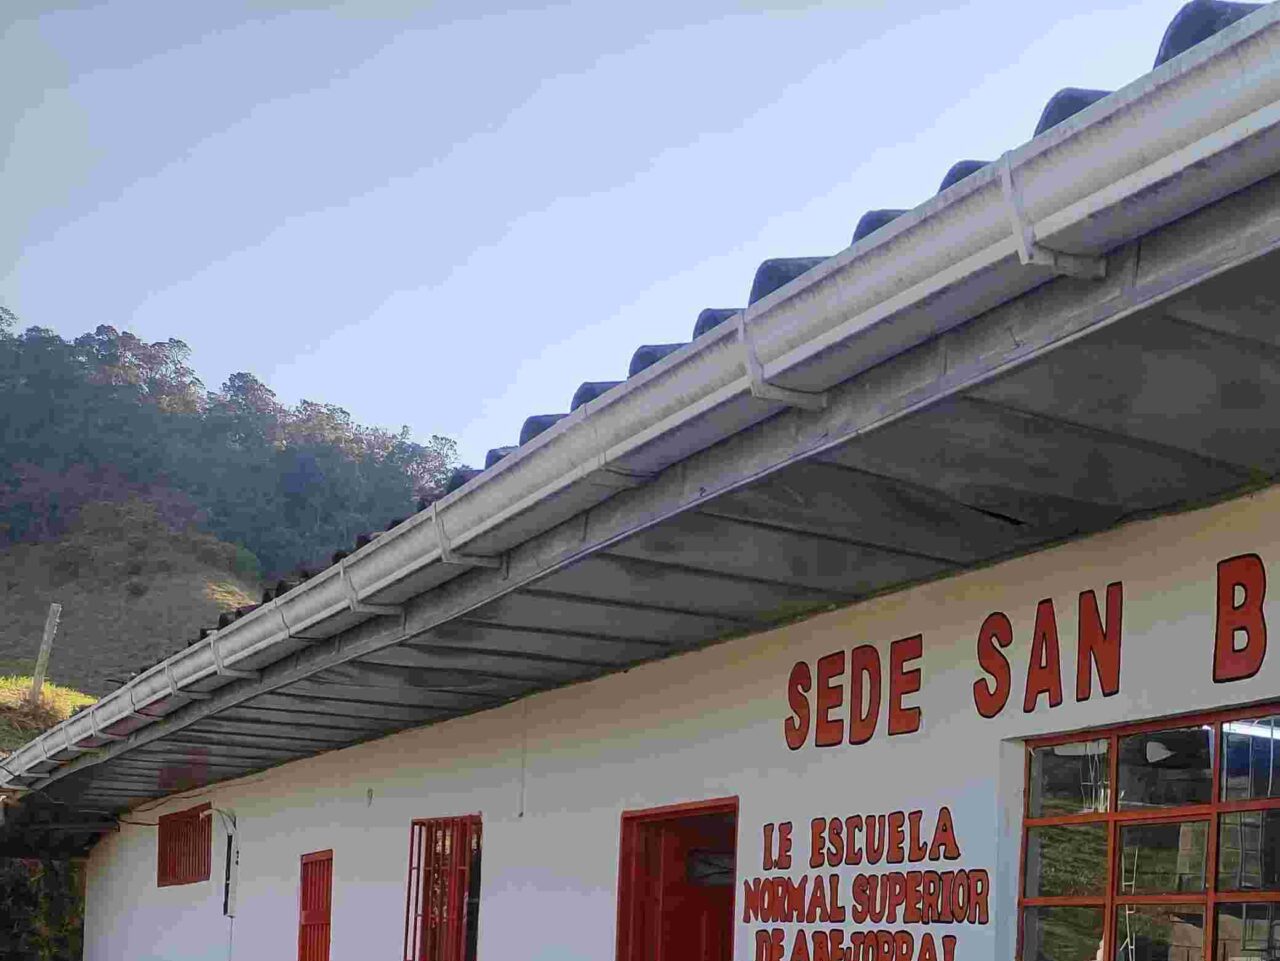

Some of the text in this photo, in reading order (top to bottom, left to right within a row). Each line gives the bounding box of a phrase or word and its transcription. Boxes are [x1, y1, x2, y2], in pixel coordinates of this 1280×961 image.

[785, 633, 923, 750] SEDE
[973, 581, 1123, 719] SAN
[810, 807, 960, 868] ESCUELA
[742, 869, 989, 926] NORMAL SUPERIOR
